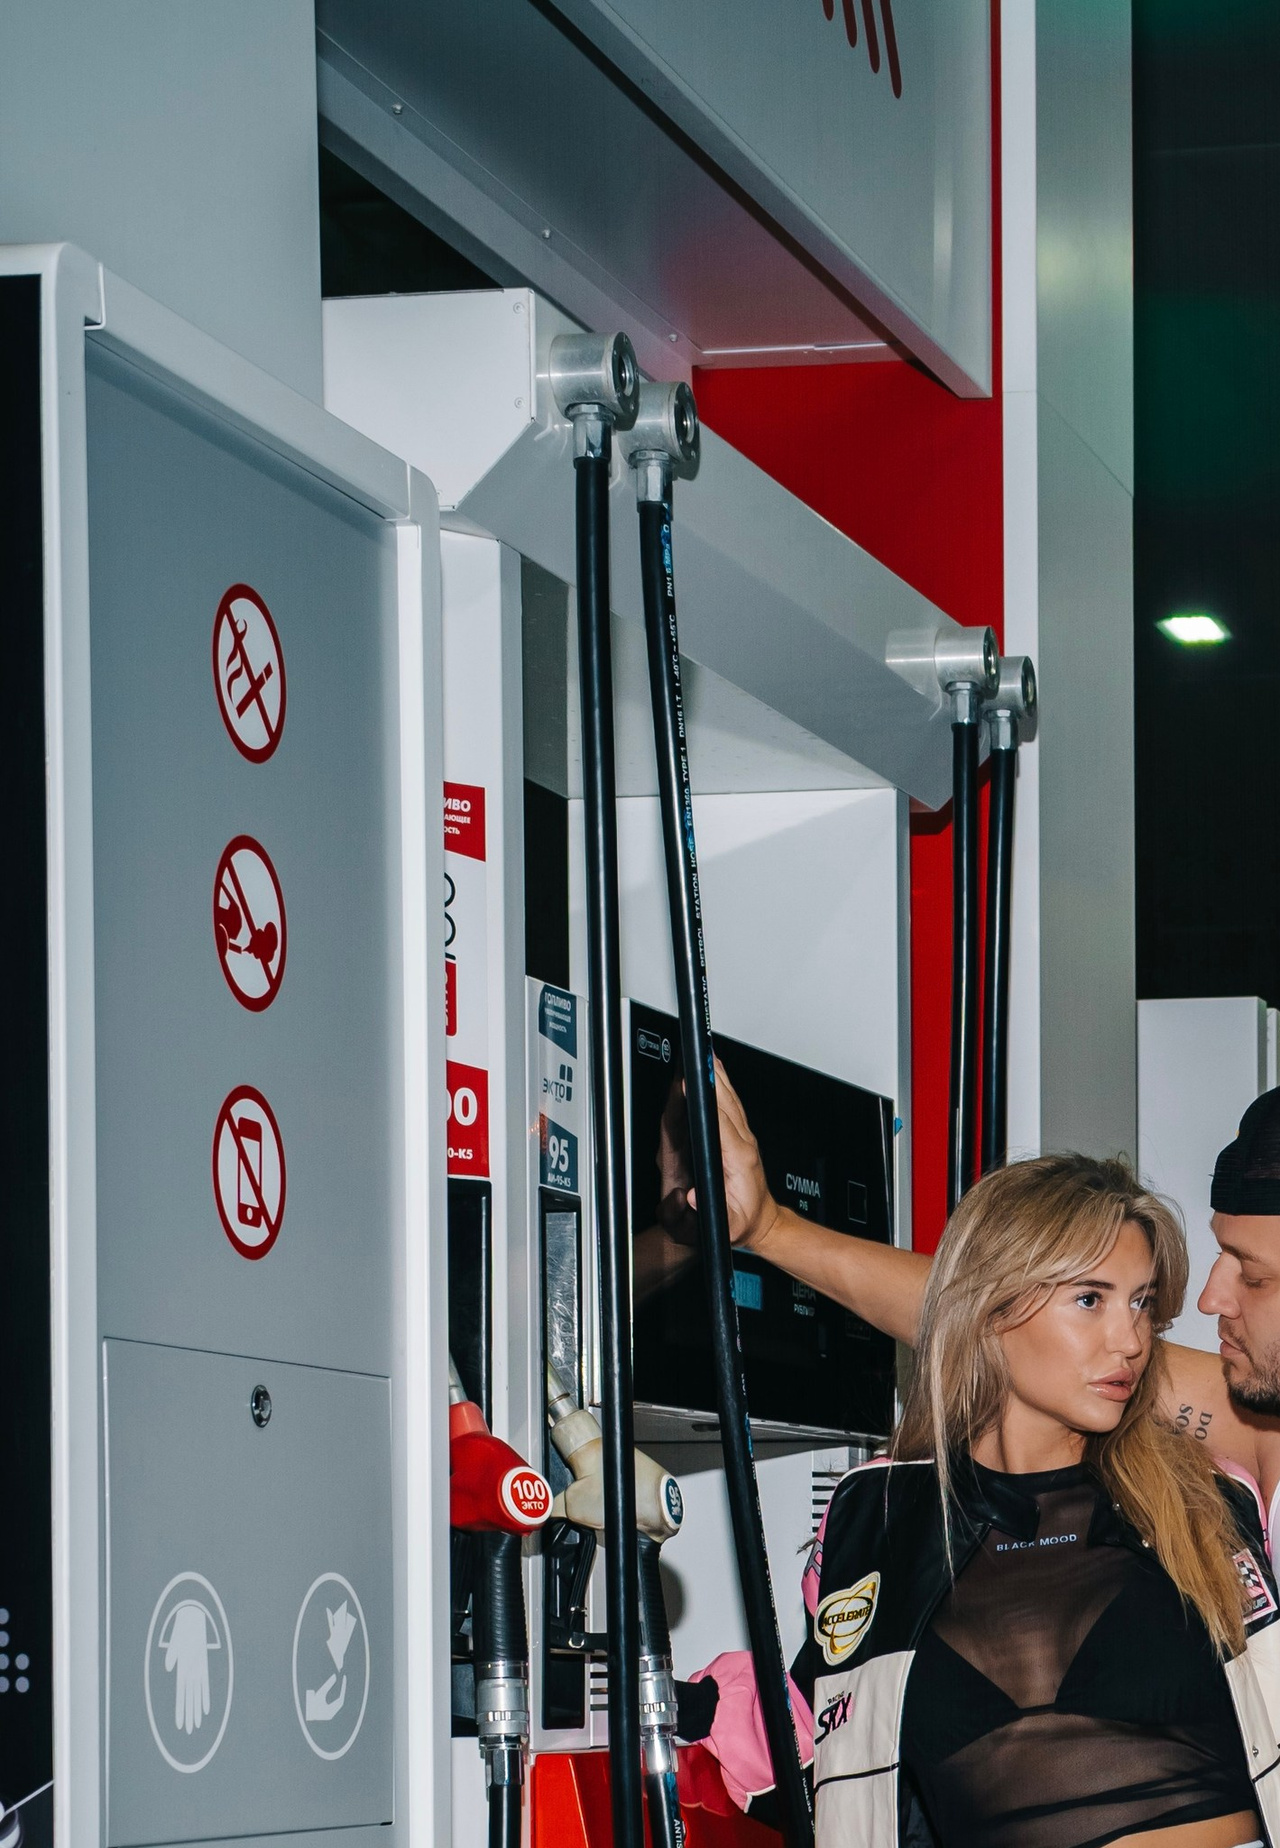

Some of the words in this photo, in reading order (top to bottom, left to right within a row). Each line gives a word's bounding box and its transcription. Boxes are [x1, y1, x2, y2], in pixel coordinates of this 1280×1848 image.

[677, 711, 685, 738] DN16
[681, 758, 689, 783] TYPE
[692, 873, 701, 919] STATION
[543, 1078, 565, 1098] ЭКТО
[549, 1135, 569, 1172] 95
[786, 1173, 821, 1198] СУММА
[512, 1478, 546, 1501] 100
[668, 1482, 681, 1507] 95
[521, 1501, 544, 1511] ЭКТО
[996, 1541, 1035, 1551] BLACK
[1039, 1533, 1077, 1546] MOOD
[822, 1604, 872, 1629] ACCELERATE
